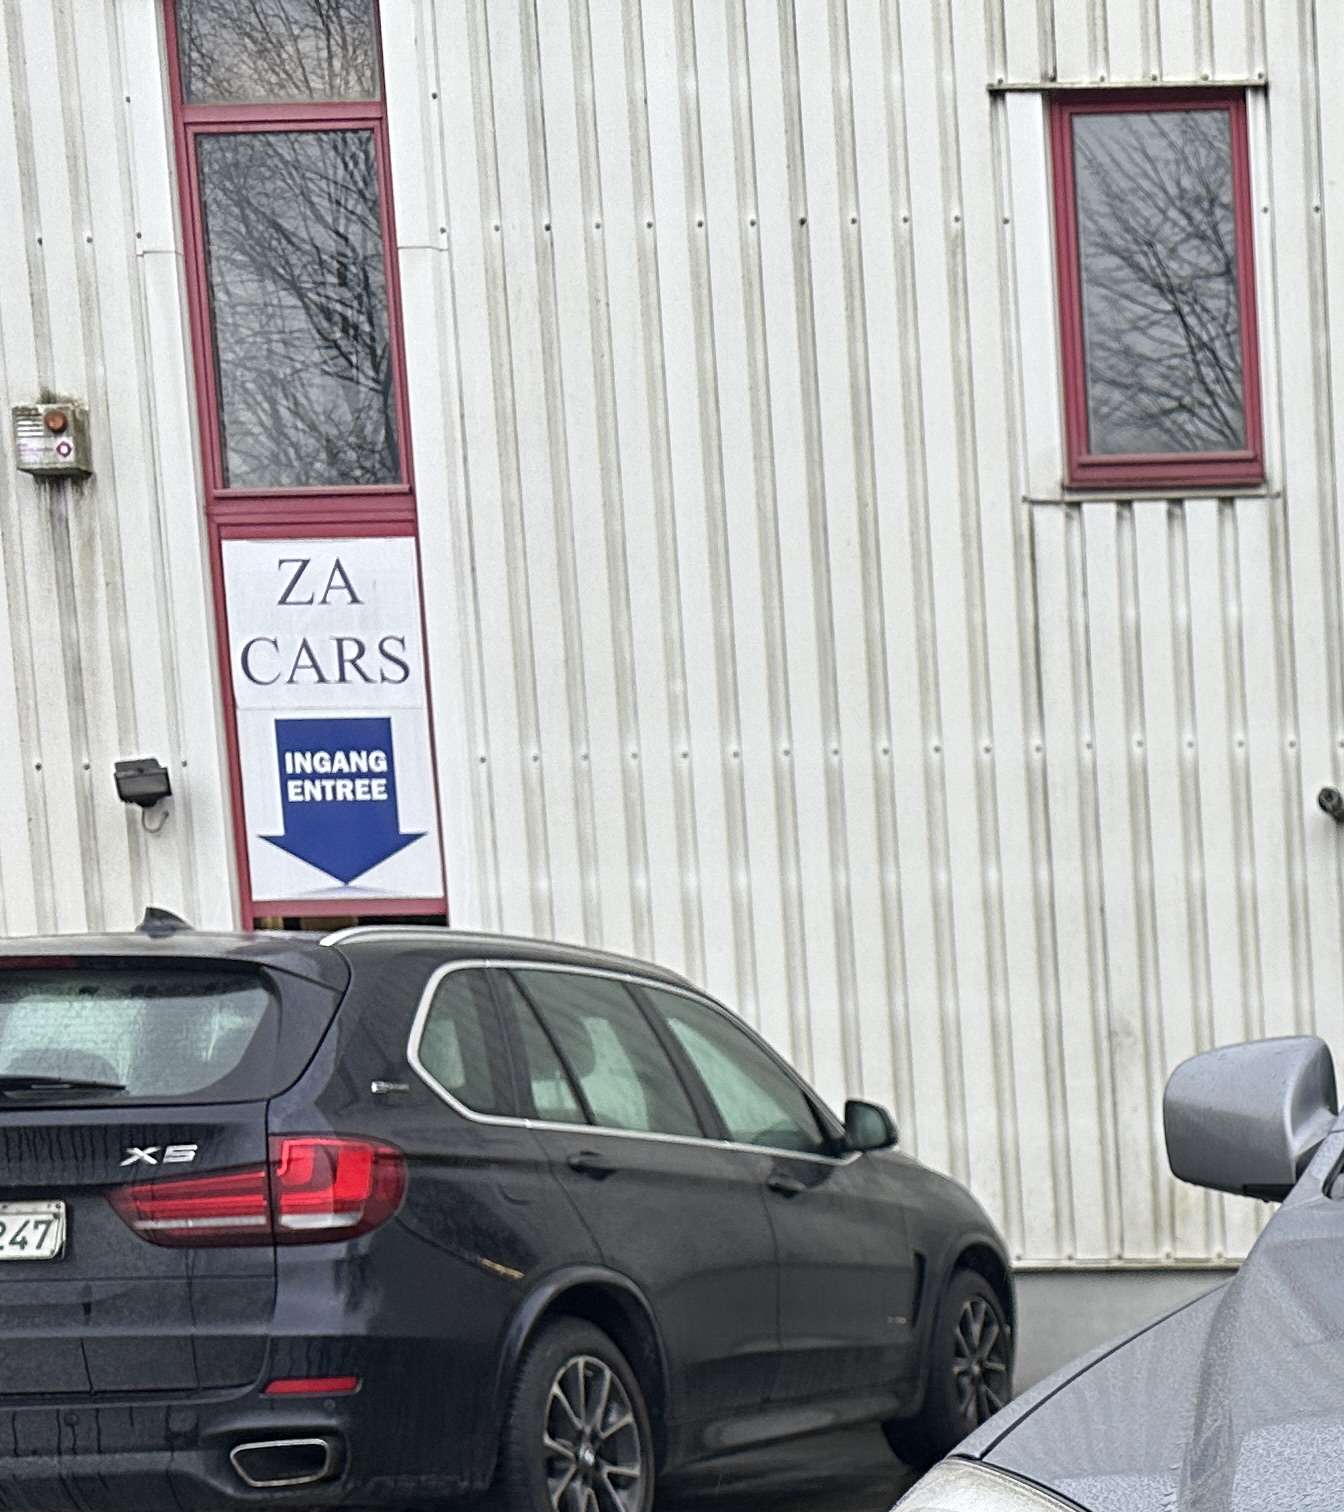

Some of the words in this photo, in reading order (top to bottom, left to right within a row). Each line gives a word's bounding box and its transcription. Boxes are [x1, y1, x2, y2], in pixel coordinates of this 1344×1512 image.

[276, 557, 365, 606] ZA
[240, 634, 410, 686] CARS
[284, 751, 388, 774] INGANG
[287, 779, 388, 802] ENTREE
[120, 1144, 198, 1166] X5
